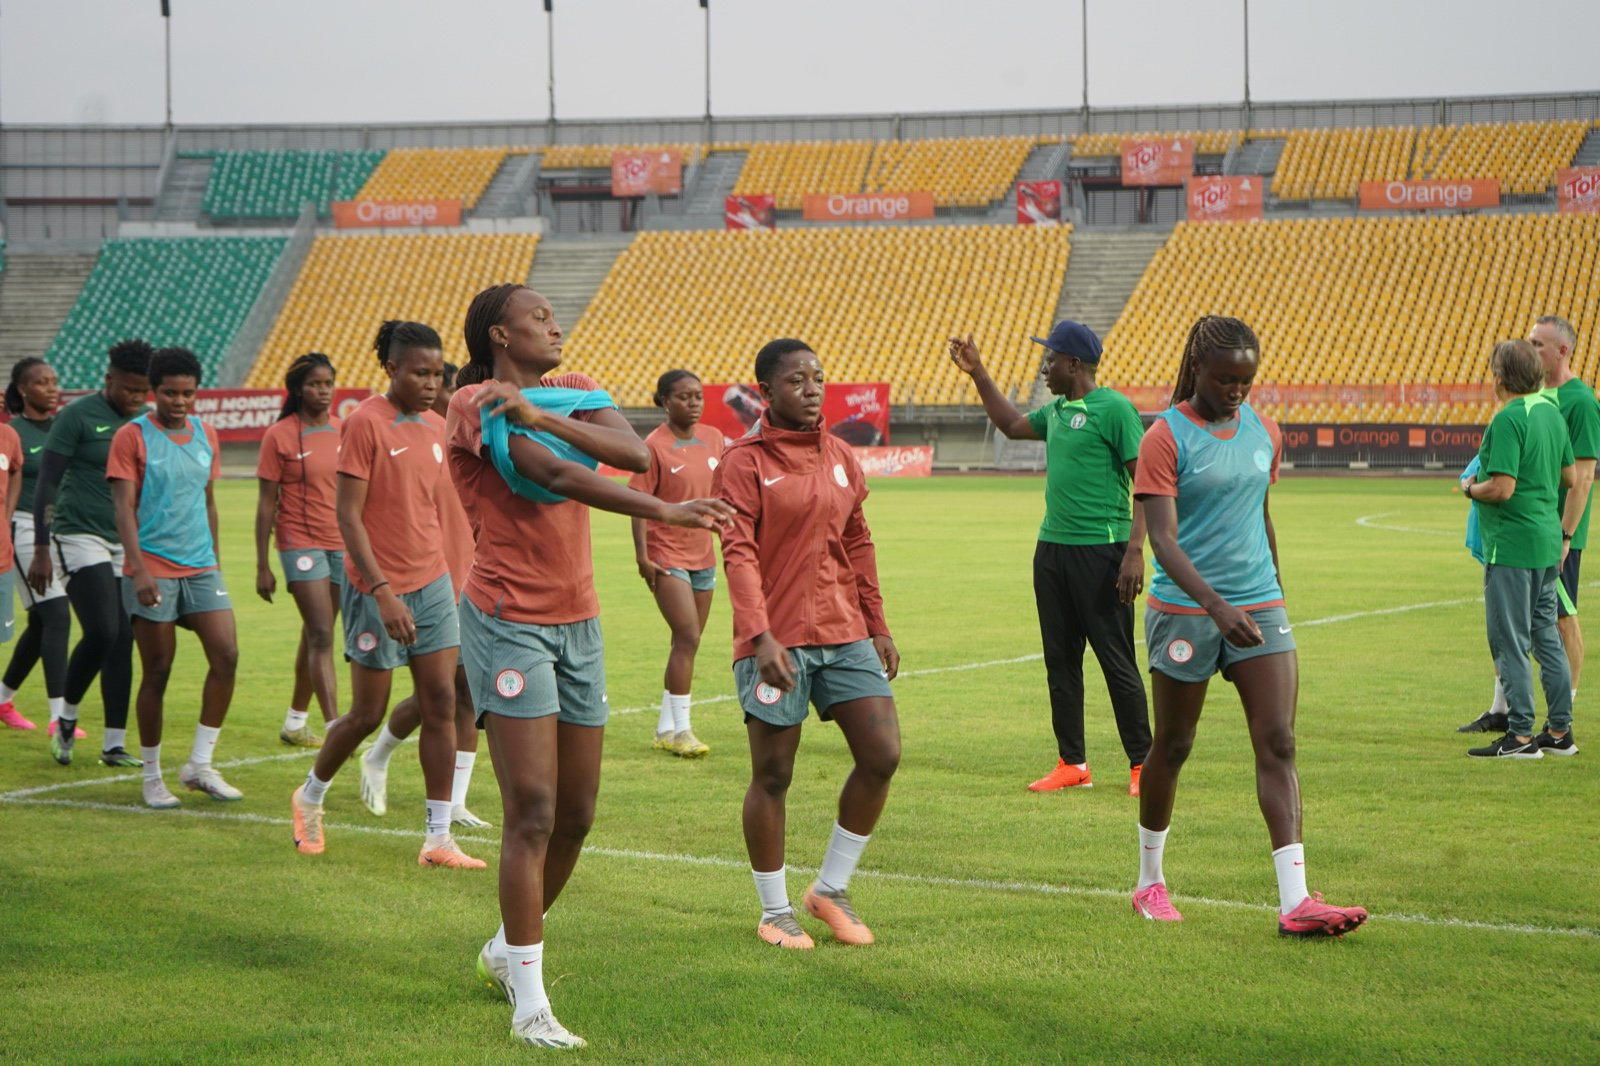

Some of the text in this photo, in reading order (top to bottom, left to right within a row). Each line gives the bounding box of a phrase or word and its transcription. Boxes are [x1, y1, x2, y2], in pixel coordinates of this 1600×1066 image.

[827, 194, 910, 219] Orange
[1386, 181, 1473, 207] Orange
[356, 201, 438, 226] Orange
[221, 395, 283, 411] MONDE
[1339, 428, 1400, 448] Orange
